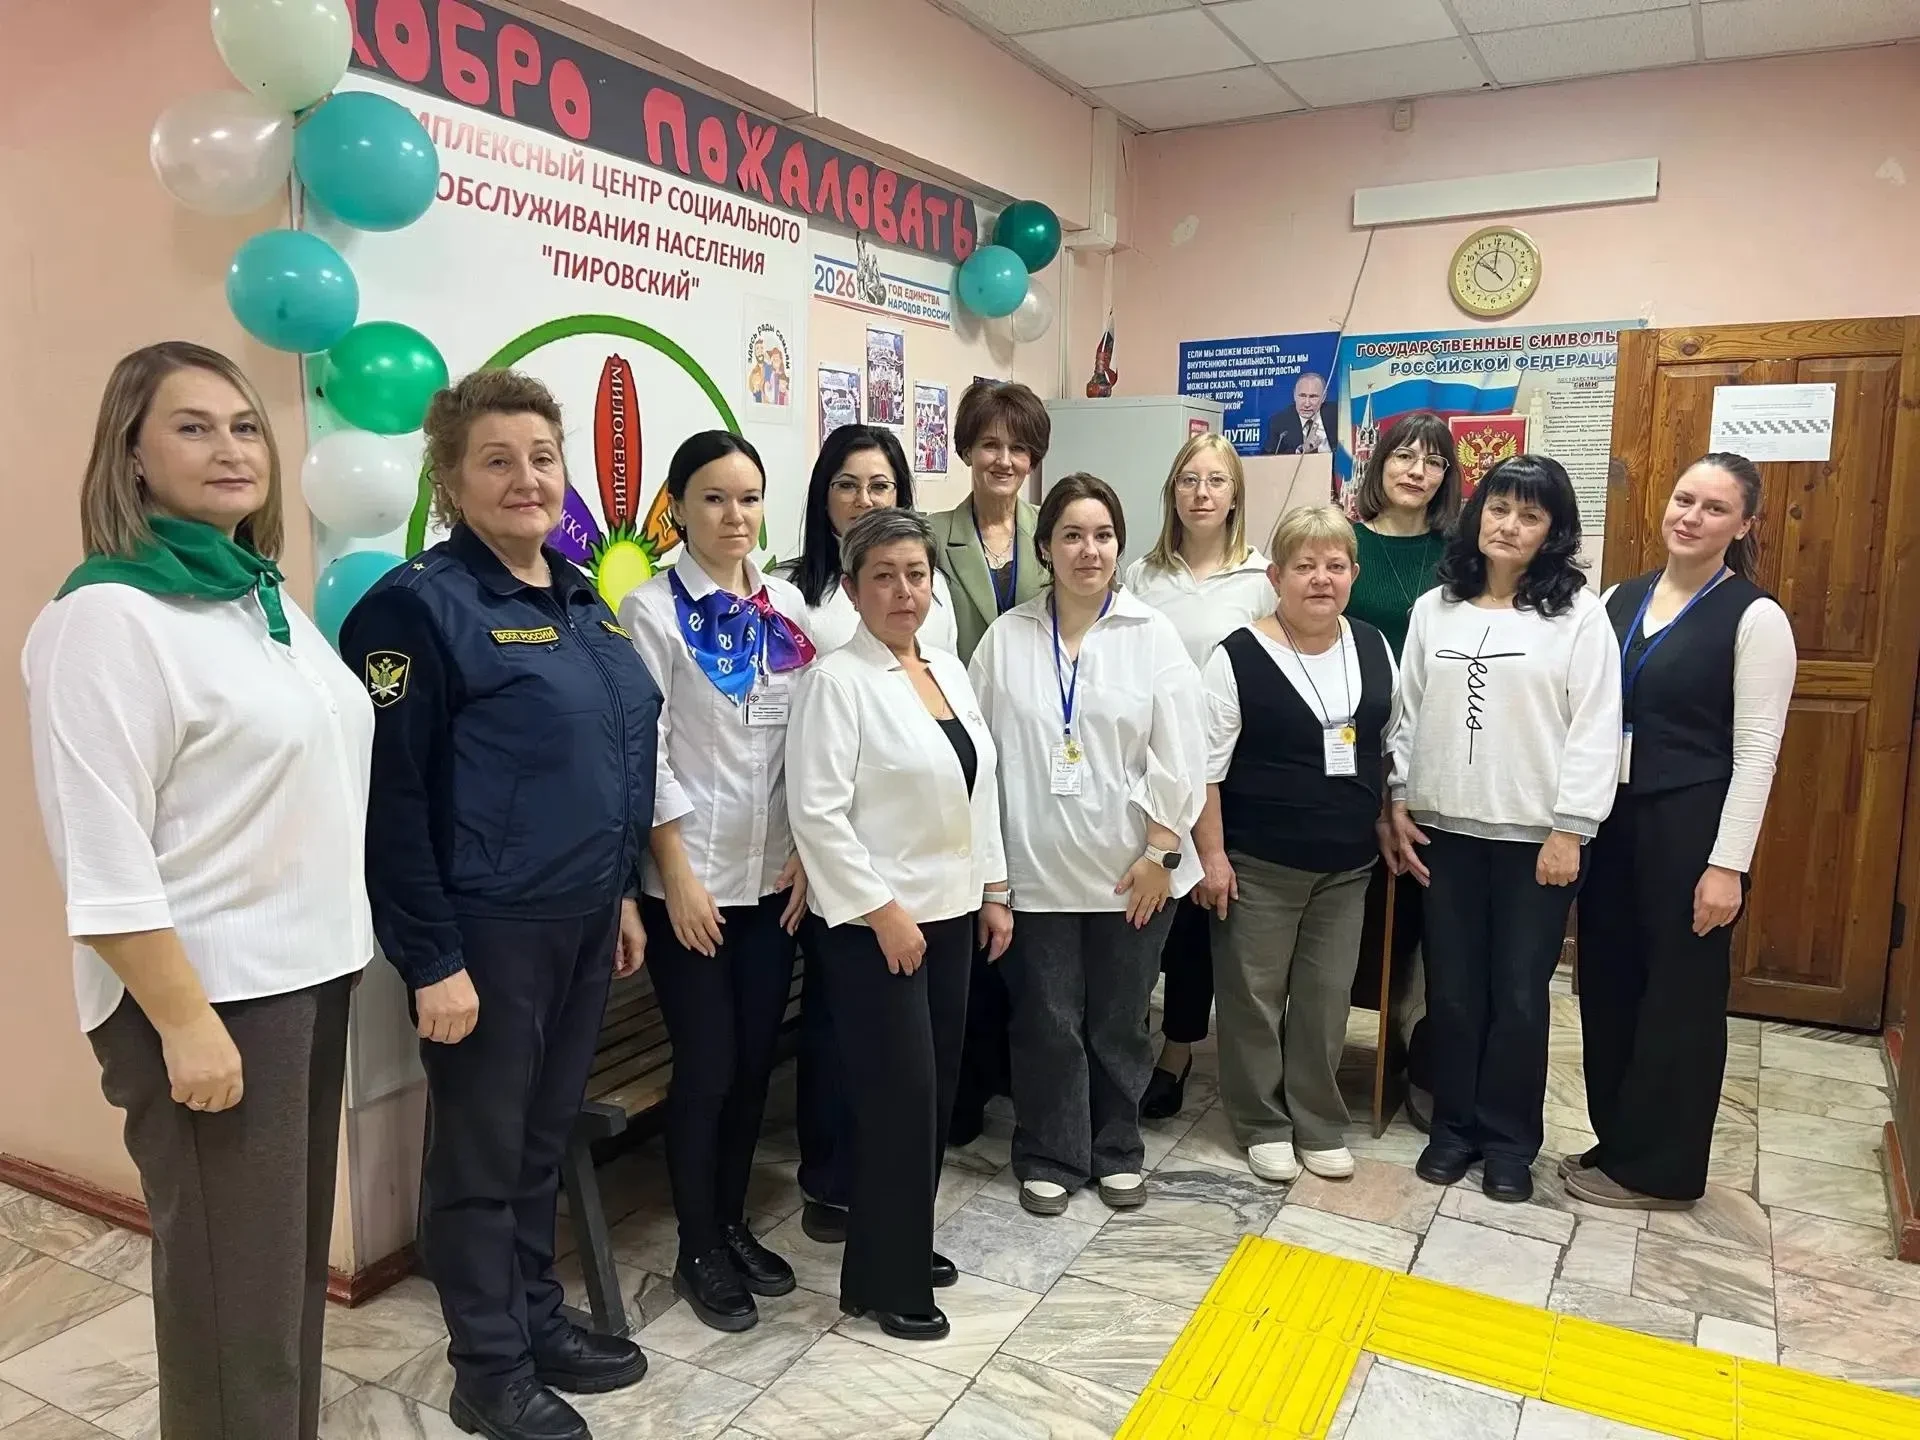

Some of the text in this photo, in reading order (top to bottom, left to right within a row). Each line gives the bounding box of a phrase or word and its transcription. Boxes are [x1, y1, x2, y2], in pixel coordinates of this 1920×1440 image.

[418, 111, 801, 244] ПЛЕКСНЫЙ ЦЕНТР СОЦИАЛЬНОГО
[643, 87, 975, 262] ПОЖАЛОВАТЬ
[435, 171, 765, 275] ОБСЛУЖИВАНИЯ НАСЕЛЕНИЯ
[1467, 254, 1475, 262] 10
[542, 244, 700, 301] "ПИРОВСКИЙ"
[814, 264, 856, 299] 2026
[888, 283, 940, 306] ГОД ЕДИНСТВА
[888, 298, 950, 321] НАРОДОВ РОССИИ
[1187, 345, 1281, 359] ЕСЛИ МЫ СМОЖЕМ ОБЕСПЕЧИТЬ
[1357, 329, 1620, 357] ГОСУДАРСТВЕННЫЕ СИМВОЛЫ
[1186, 365, 1301, 380] С ПОЛНЫМ ОСНОВАНИЕМ И ГОРДОСТЬЮ
[1187, 359, 1228, 369] ВНУТРЕННЮЮ
[1276, 354, 1296, 364] ТОГДА
[1297, 353, 1309, 363] МЫ
[1390, 350, 1617, 376] РОССИЙСКОЙ ФЕДЕРАЦИ
[1186, 381, 1209, 391] МОЖЕМ
[1238, 379, 1251, 388] ЧТО
[1251, 377, 1274, 387] ЖИВЕМ
[1215, 391, 1244, 400] КОТОРУЮ
[611, 366, 628, 518] МИЛОСЕРДИЕ
[1224, 428, 1260, 443] ПУТИН
[496, 630, 556, 641] ФССП РОССИИ
[1435, 626, 1526, 765] Jesus
